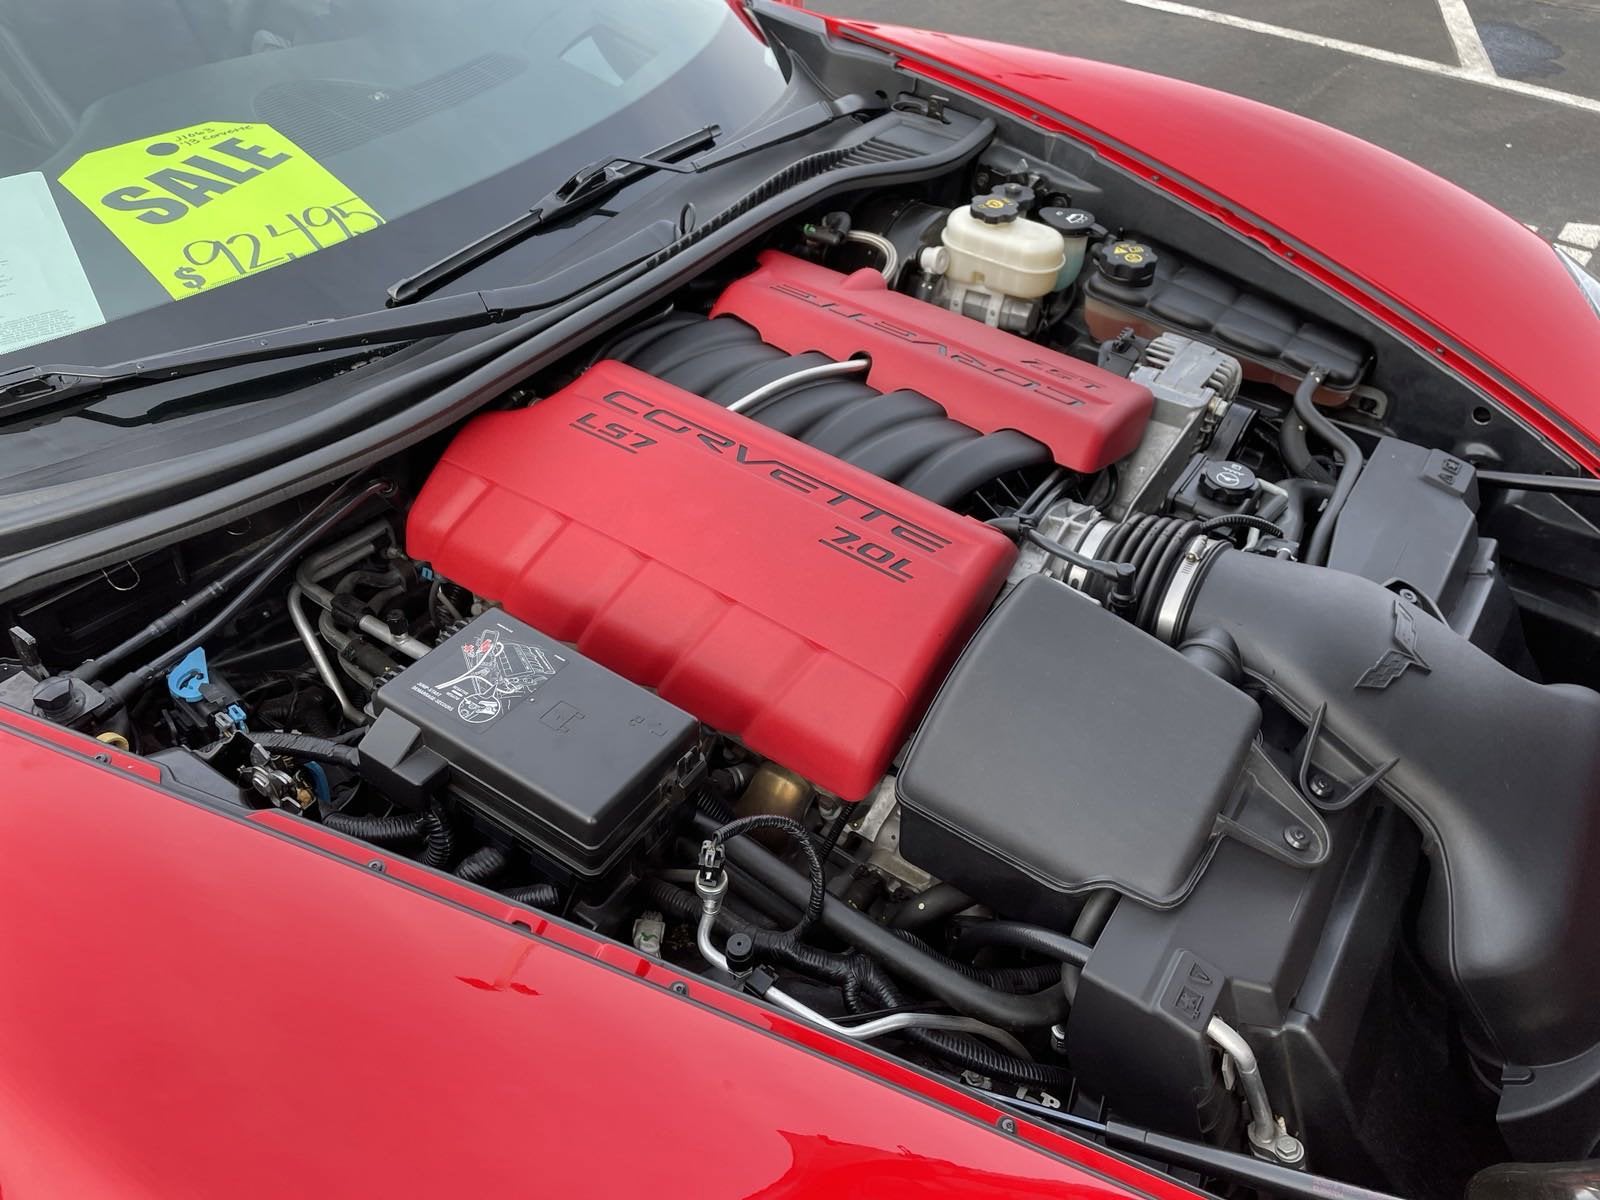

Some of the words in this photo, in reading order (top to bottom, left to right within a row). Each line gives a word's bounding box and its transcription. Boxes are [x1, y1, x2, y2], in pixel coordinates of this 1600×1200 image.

[101, 137, 293, 225] SALE
[771, 283, 1087, 407] CORVETTE
[574, 412, 659, 450] LS7
[602, 390, 953, 553] CORVETTE
[824, 525, 915, 580] 7.0L
